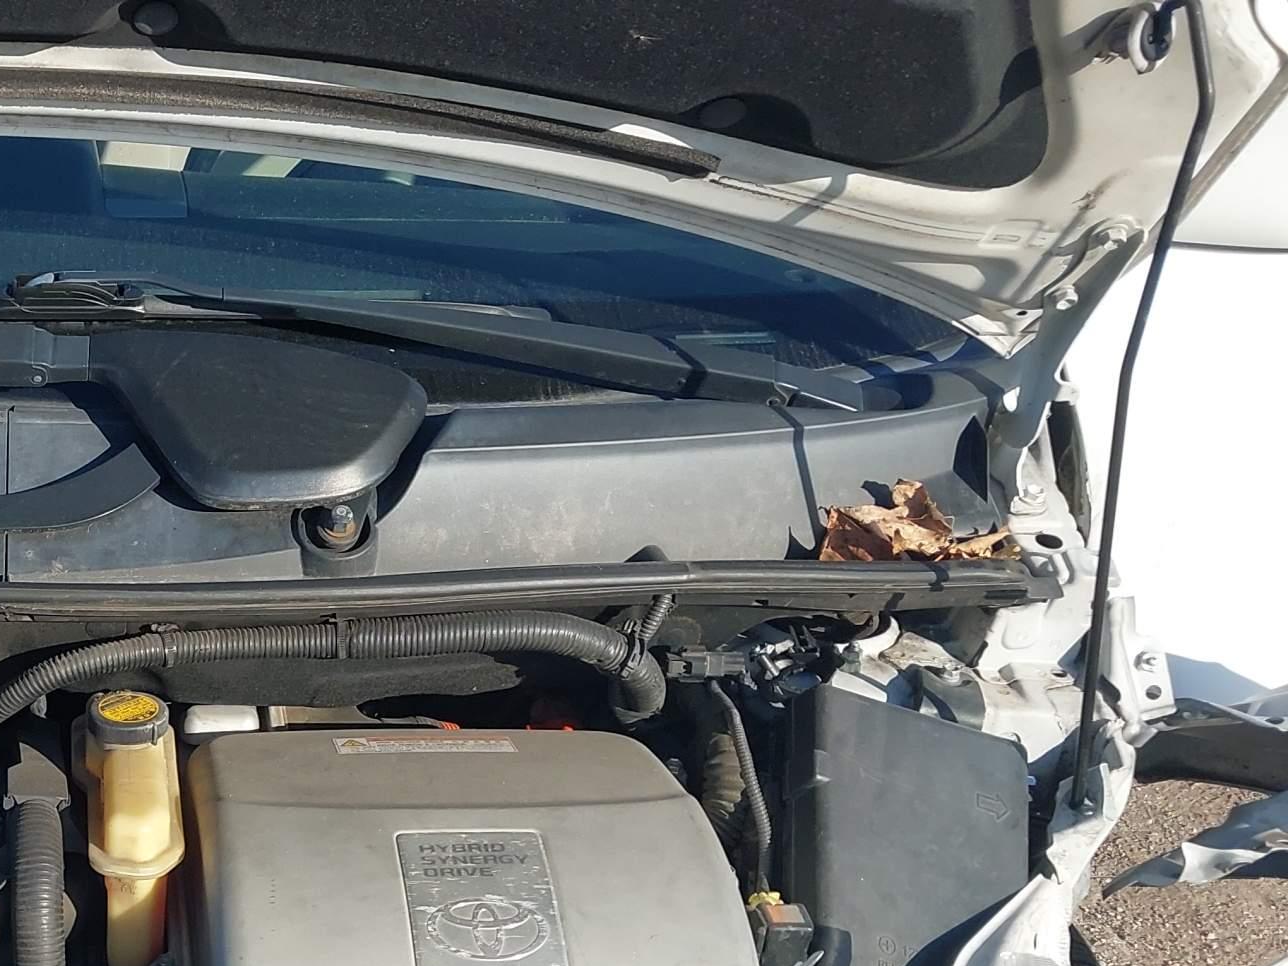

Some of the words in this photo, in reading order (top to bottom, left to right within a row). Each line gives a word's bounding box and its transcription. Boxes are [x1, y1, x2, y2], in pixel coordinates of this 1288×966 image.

[418, 842, 505, 853] HYBRID
[420, 855, 528, 865] SYNERGY
[423, 867, 494, 877] DRIVE
